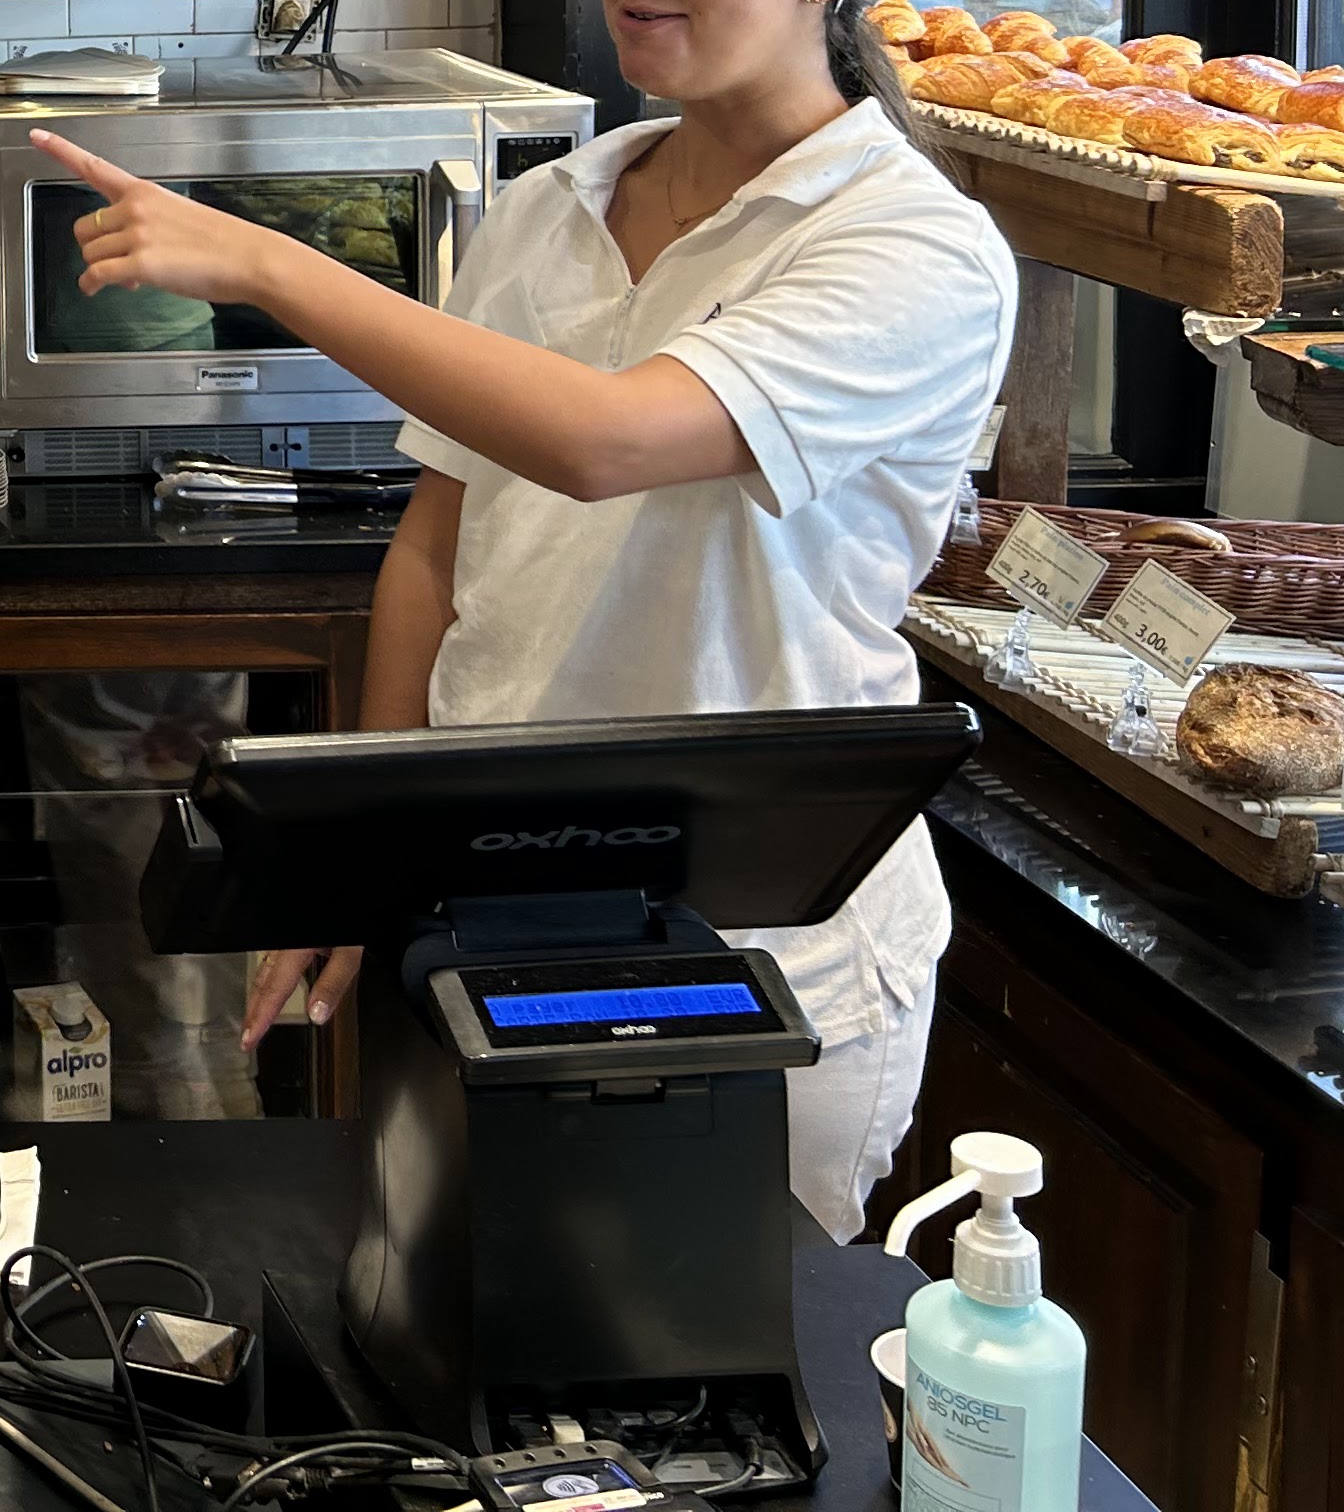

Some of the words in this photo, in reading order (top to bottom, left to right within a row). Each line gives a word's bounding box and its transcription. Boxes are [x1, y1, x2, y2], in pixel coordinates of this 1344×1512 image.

[201, 369, 254, 379] Panasonic
[1018, 569, 1051, 600] 2,70€
[1134, 623, 1169, 656] 3,00€
[469, 825, 682, 851] oxhoo
[46, 1048, 108, 1078] alpro
[56, 1082, 100, 1102] BARISTA
[915, 1372, 1007, 1422] ANIOSGEL
[926, 1395, 948, 1418] 85
[952, 1409, 991, 1434] NPC
